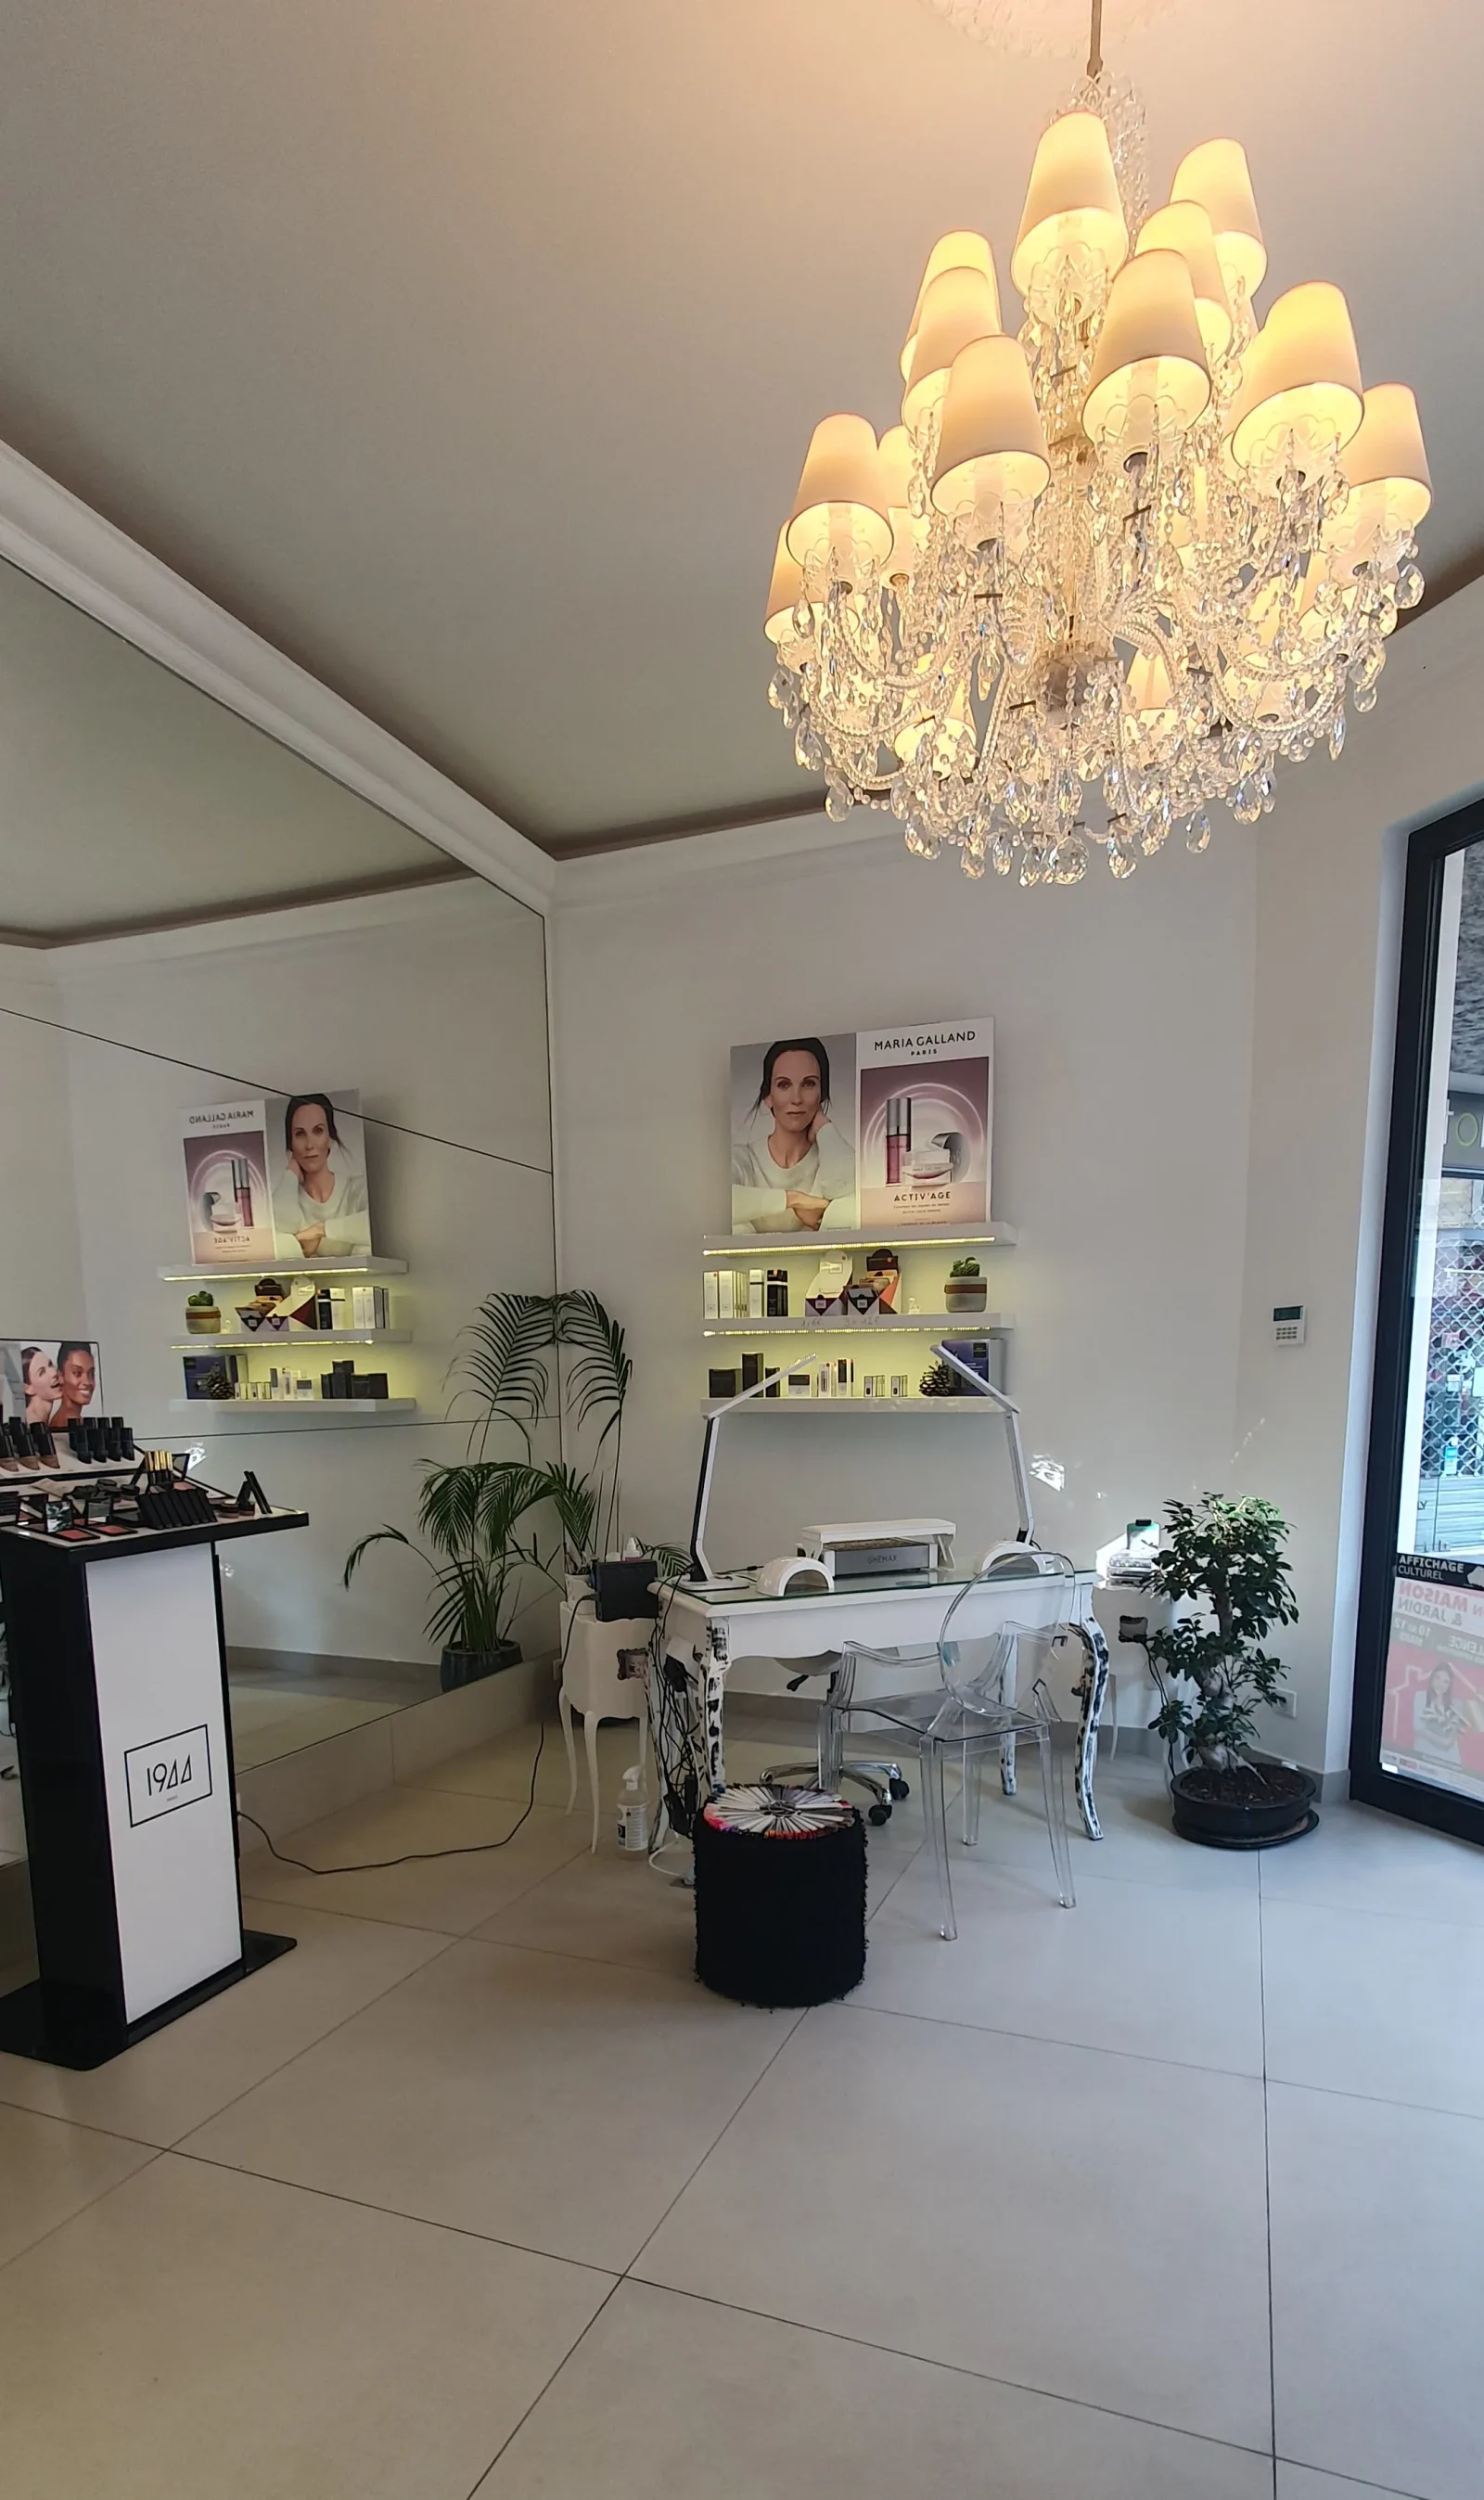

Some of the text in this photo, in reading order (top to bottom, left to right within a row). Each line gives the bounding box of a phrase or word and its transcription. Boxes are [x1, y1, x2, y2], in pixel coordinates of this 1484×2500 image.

[874, 1031, 976, 1051] MARIA GALLAND
[893, 1191, 951, 1202] ACTIV'AGE
[1398, 1565, 1444, 1581] CULTUREL
[1399, 1555, 1465, 1573] AFFICHAGE
[147, 1754, 192, 1796] 1944
